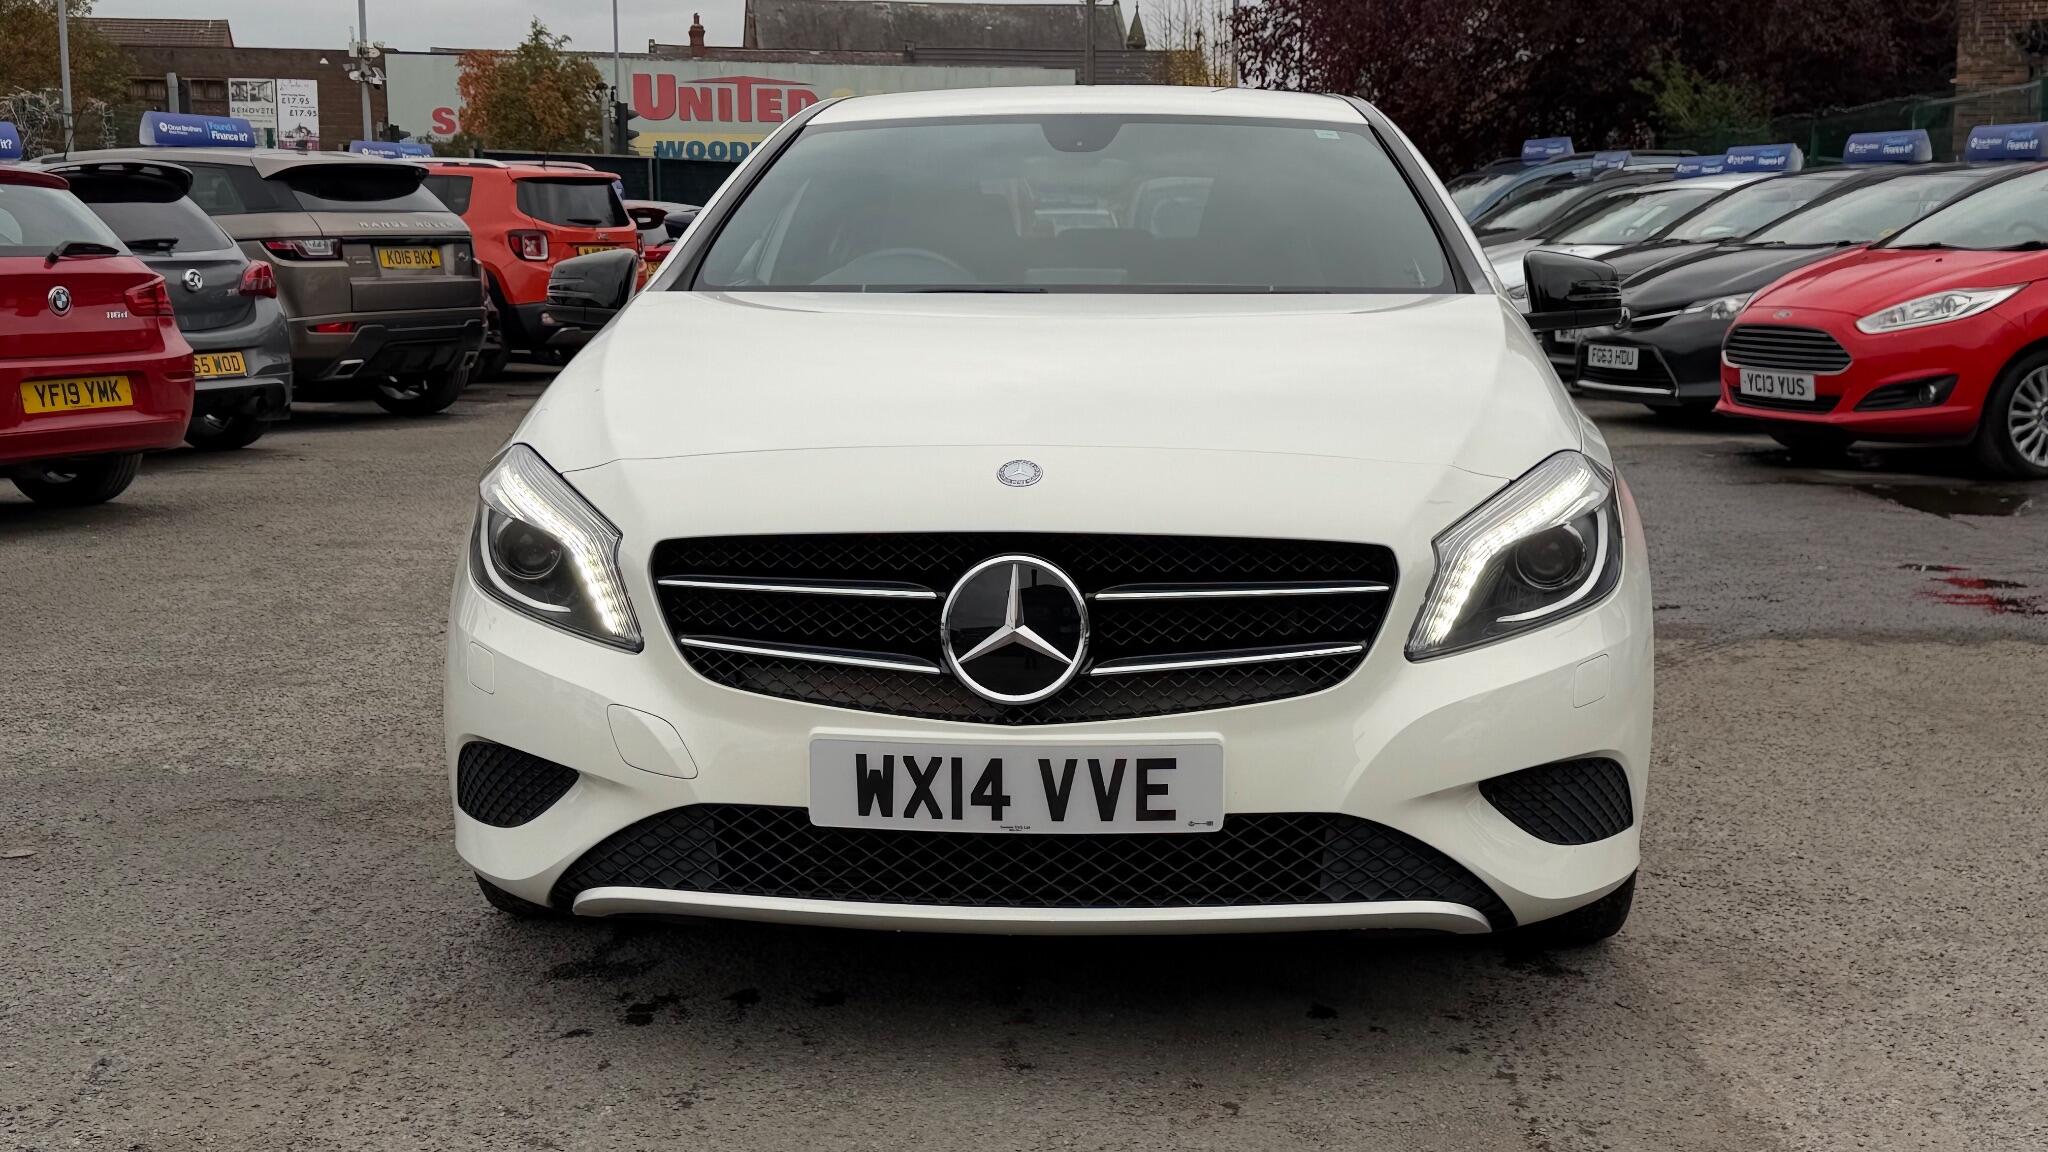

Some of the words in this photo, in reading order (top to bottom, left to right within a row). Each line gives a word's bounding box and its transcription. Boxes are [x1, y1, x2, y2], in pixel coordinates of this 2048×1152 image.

[633, 74, 819, 122] UNITED
[289, 109, 317, 117] £17.95
[413, 249, 435, 265] BKX
[212, 355, 241, 373] WOD
[1615, 349, 1634, 366] HDU
[34, 382, 81, 407] YF19
[84, 379, 122, 403] YMK
[1747, 373, 1774, 393] YC13
[1778, 375, 1805, 396] YUS
[855, 753, 1011, 821] WX14
[1038, 758, 1177, 822] VVE
